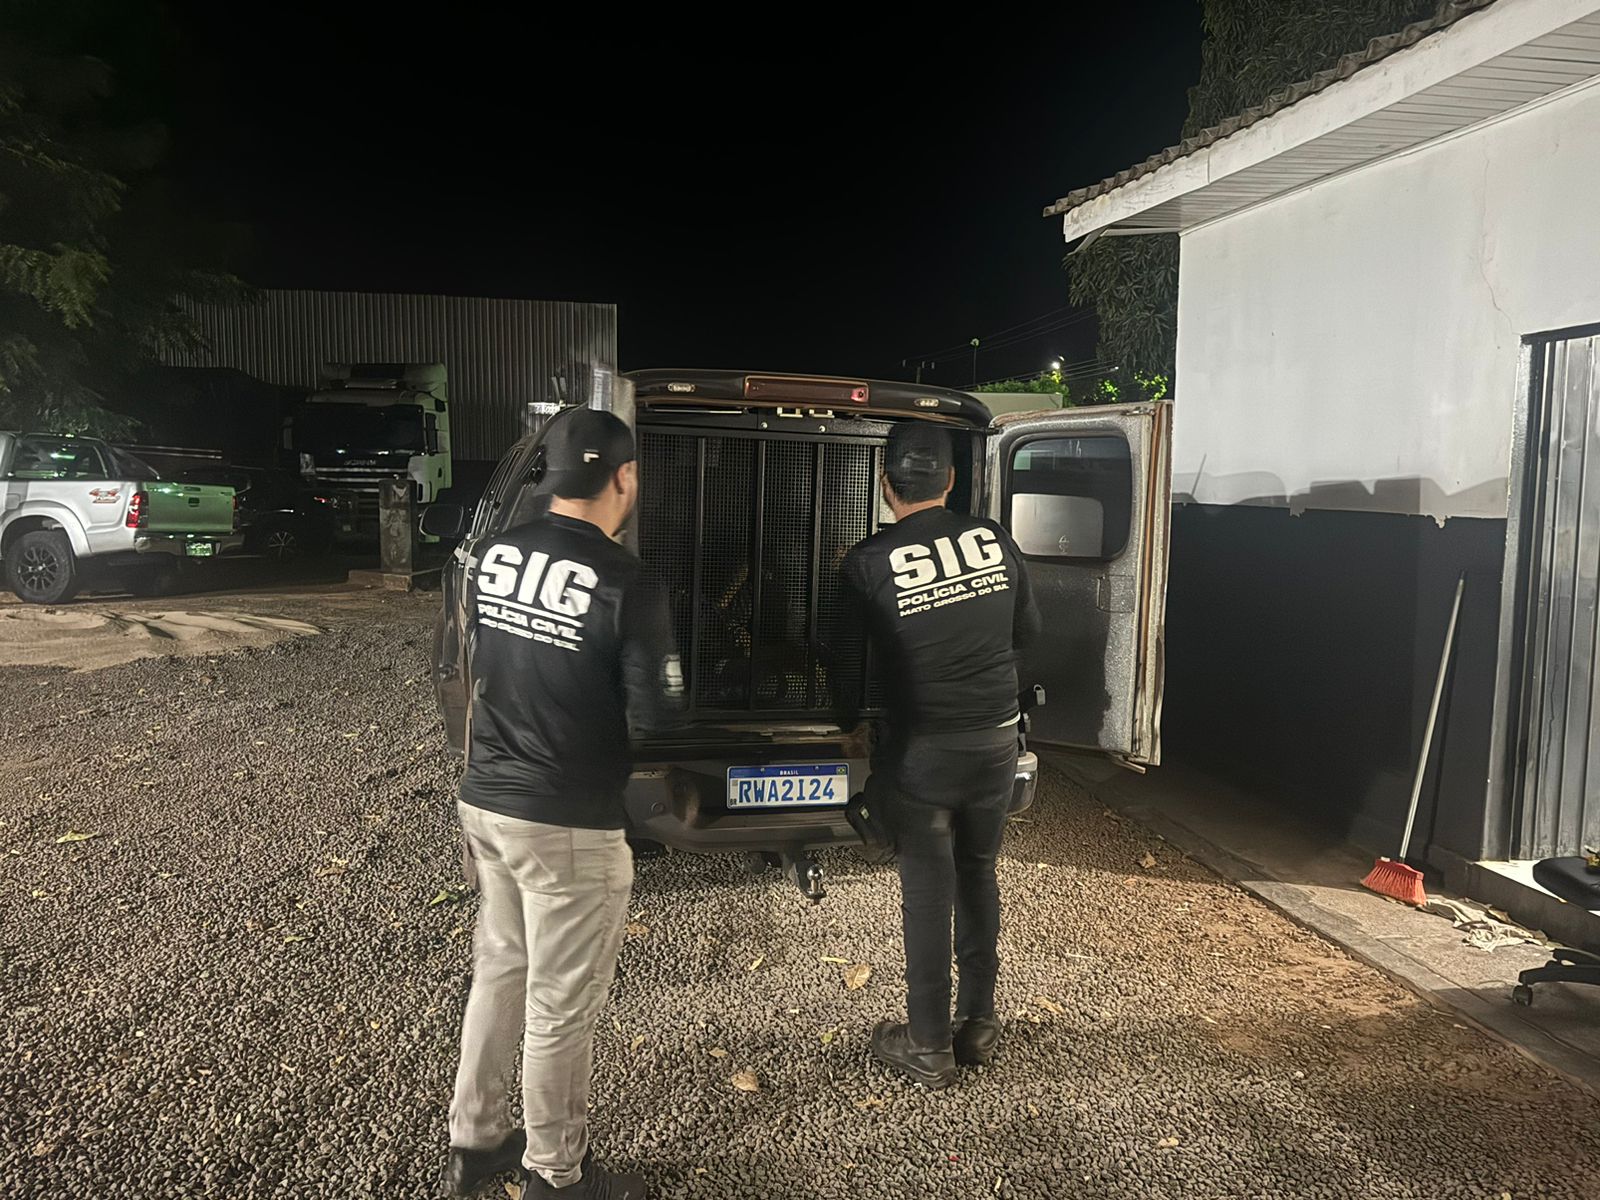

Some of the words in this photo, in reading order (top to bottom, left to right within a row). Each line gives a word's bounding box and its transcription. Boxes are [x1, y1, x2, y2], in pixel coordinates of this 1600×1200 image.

[477, 543, 599, 618] SIG
[888, 526, 1004, 590] SIG
[897, 583, 968, 609] POLÍCIA
[970, 572, 1009, 589] CIVIL
[899, 603, 932, 617] MATO
[933, 590, 977, 608] GROSSO
[977, 586, 992, 596] DO
[993, 582, 1010, 591] SUL
